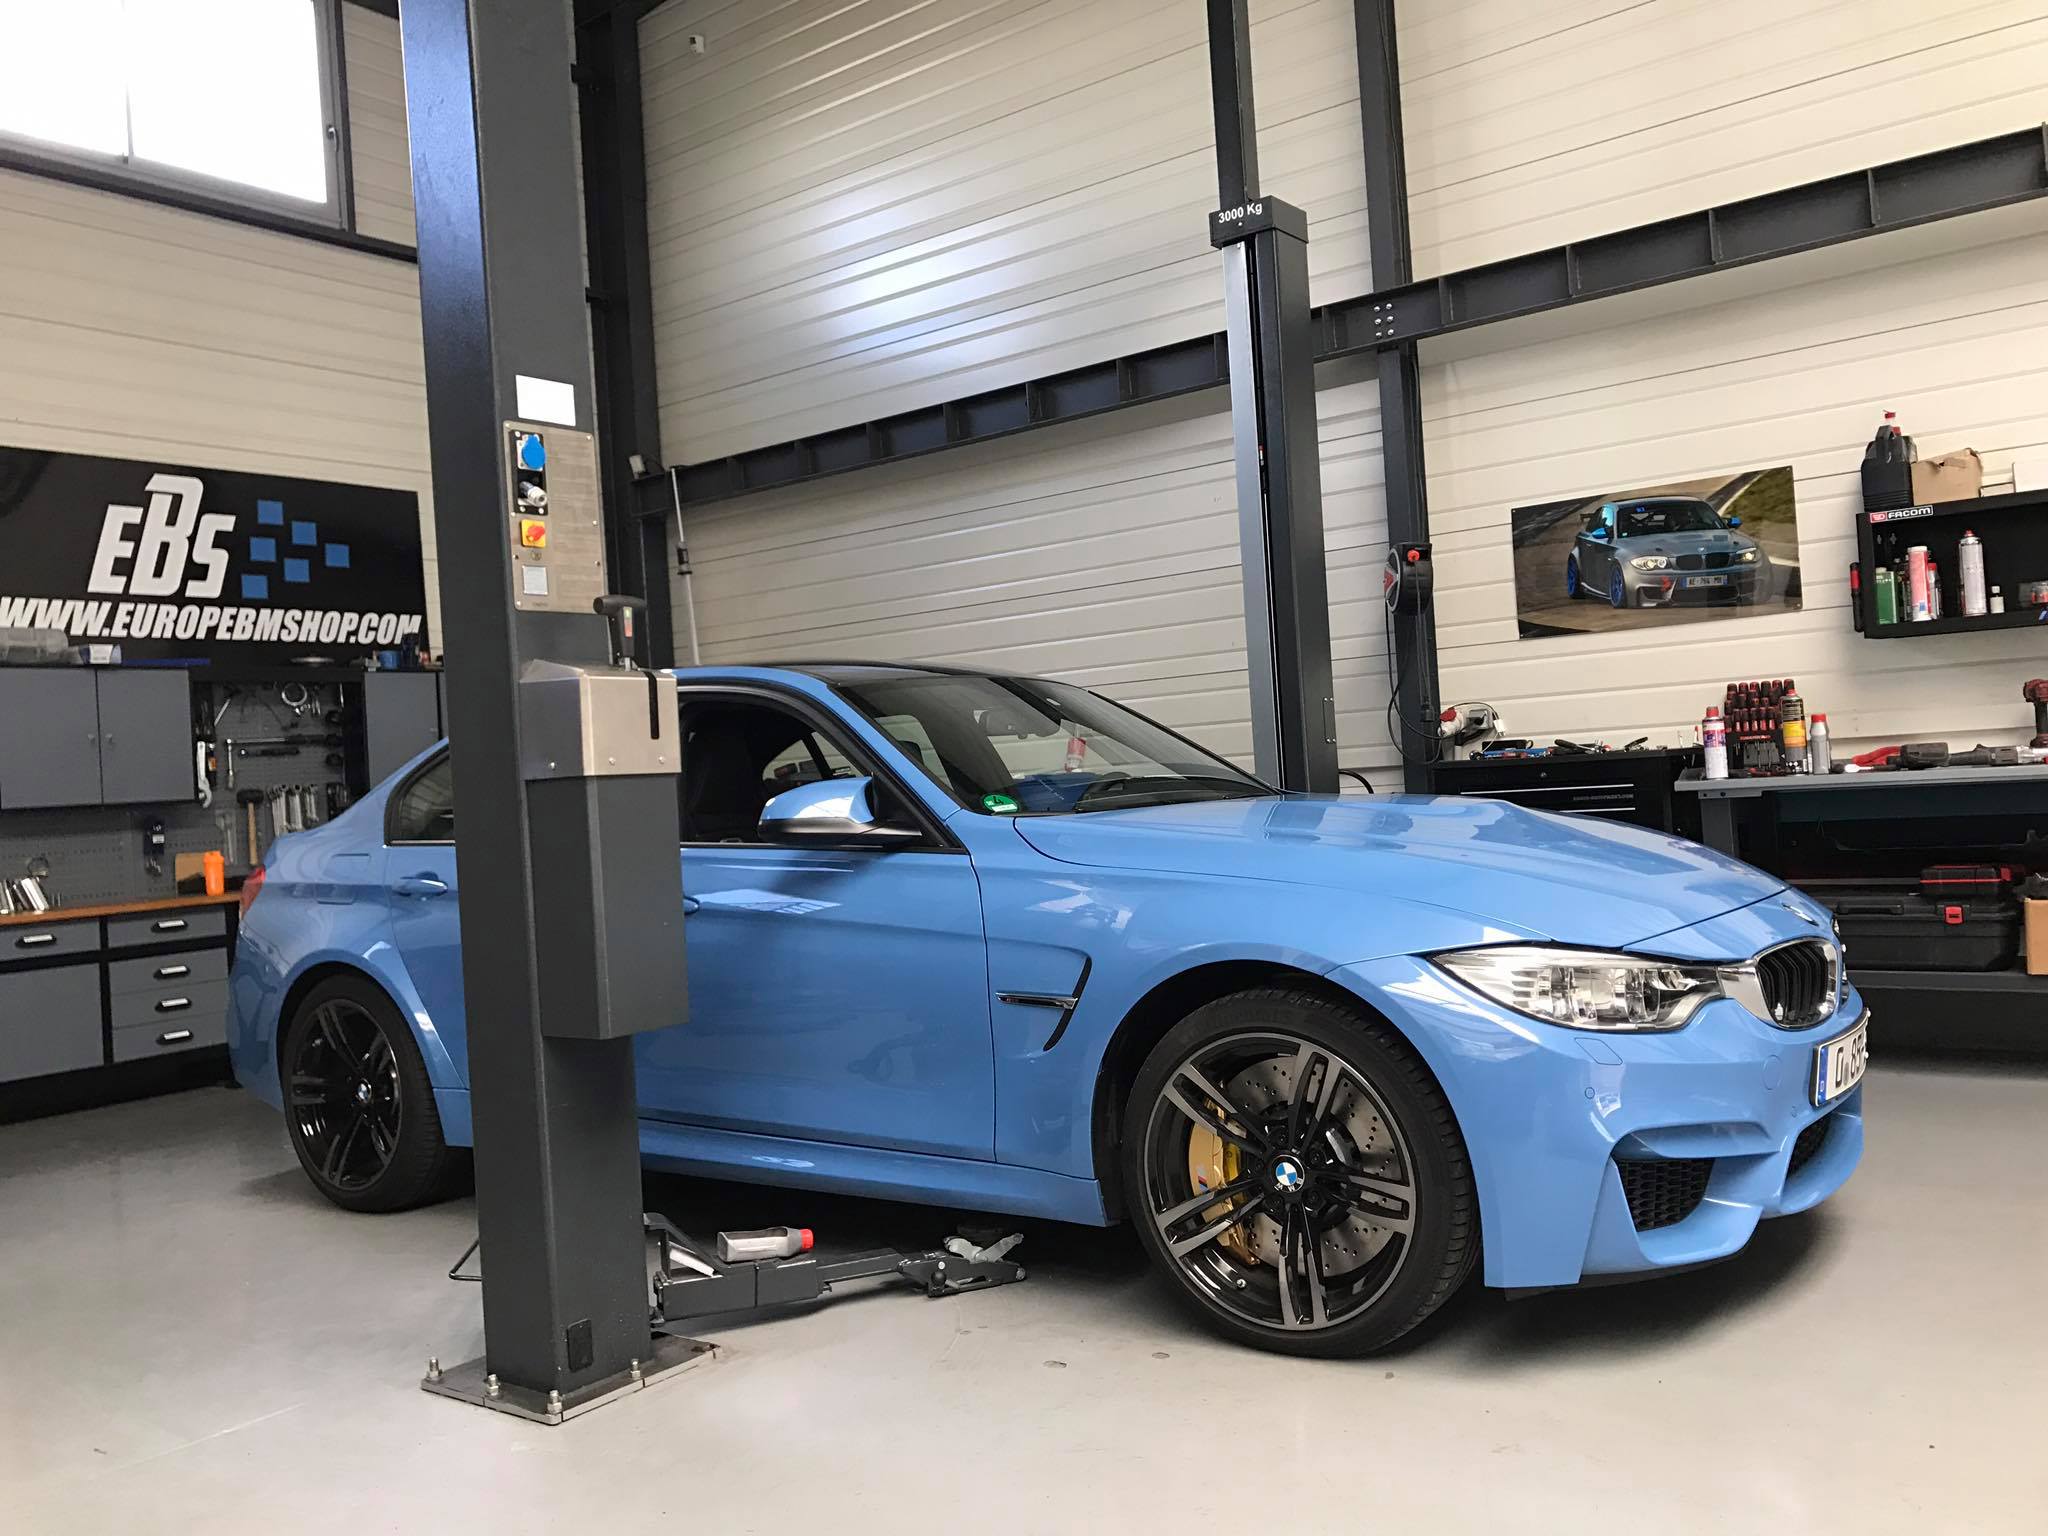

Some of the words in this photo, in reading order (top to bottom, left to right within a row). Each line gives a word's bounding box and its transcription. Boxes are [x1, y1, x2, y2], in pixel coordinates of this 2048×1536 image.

[1218, 206, 1244, 223] 3000
[1246, 202, 1263, 216] Kg
[1888, 507, 1931, 519] FACOM
[87, 473, 236, 599] EBS
[0, 596, 422, 645] WWW.EUROPEBMSHOP.COM
